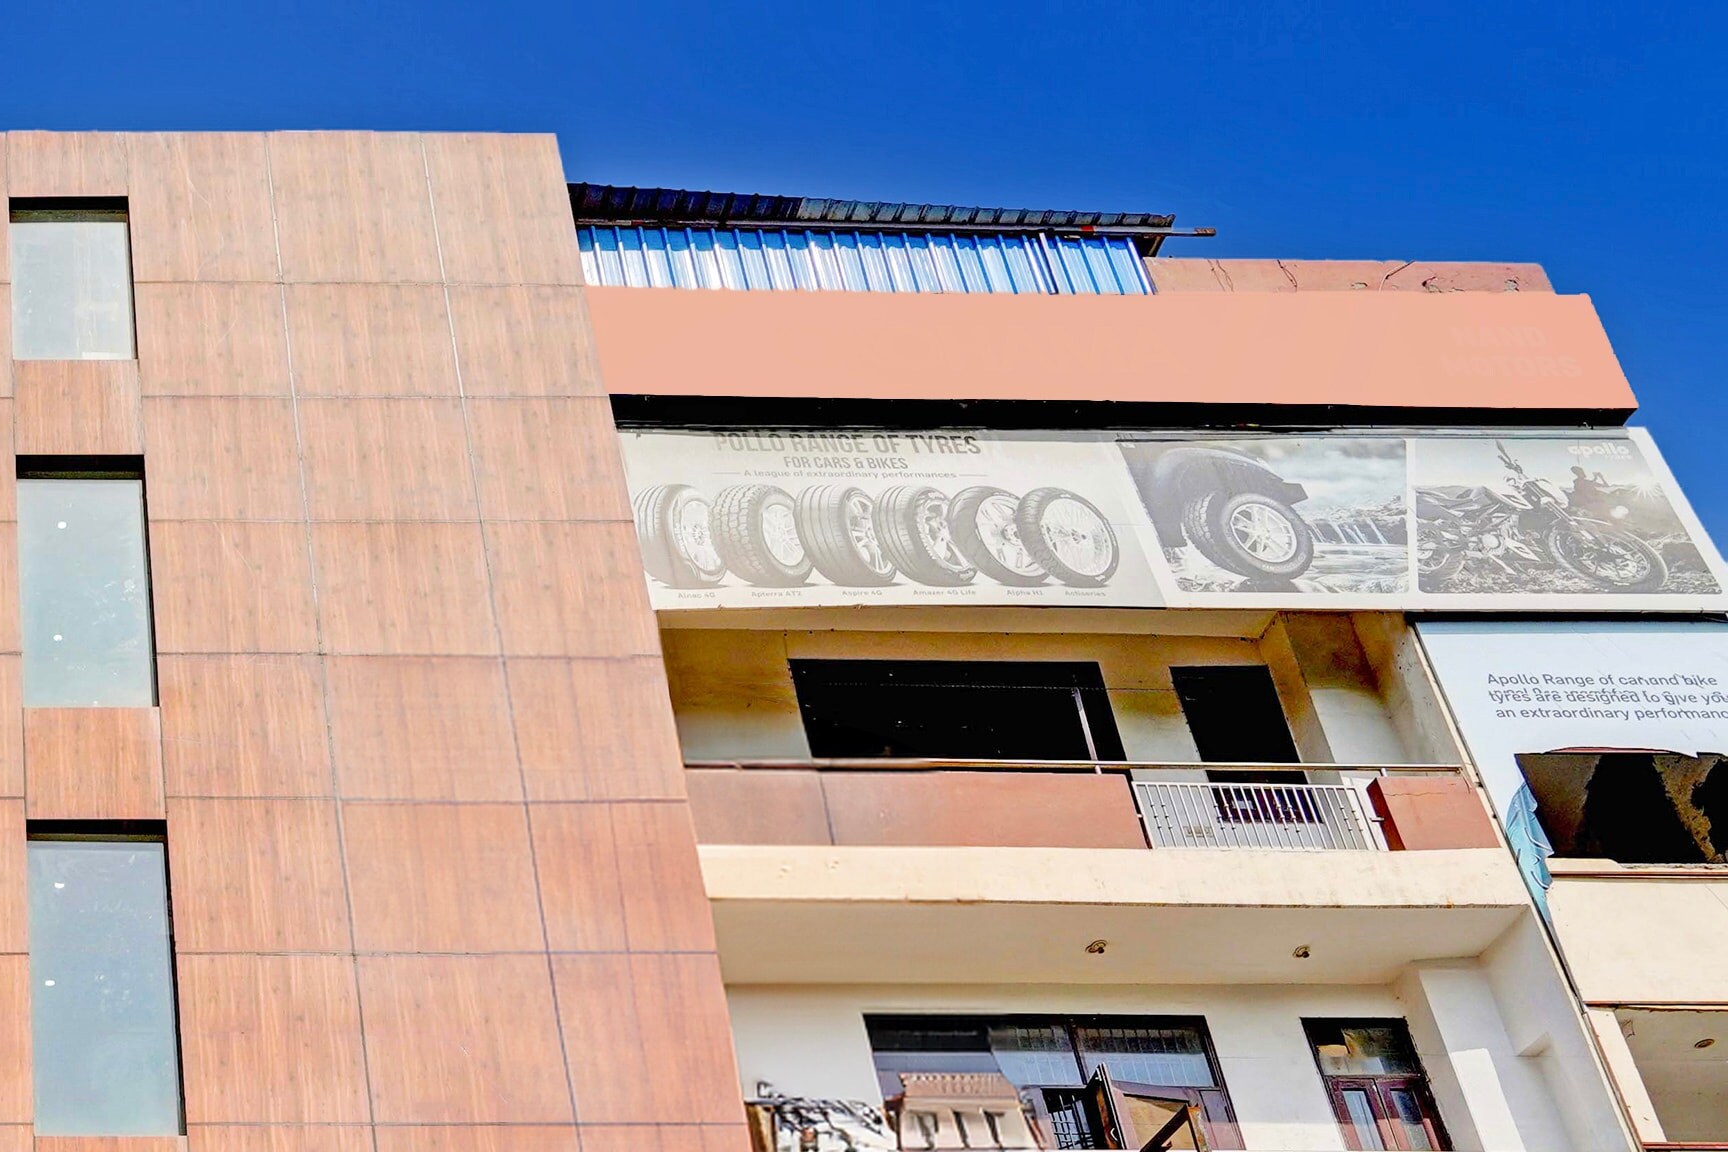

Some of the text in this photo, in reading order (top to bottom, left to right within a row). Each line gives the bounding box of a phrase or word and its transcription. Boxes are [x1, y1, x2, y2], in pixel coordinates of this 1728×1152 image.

[789, 433, 869, 452] RANGE
[872, 434, 901, 453] OF
[905, 435, 981, 454] TYRES
[784, 456, 811, 468] FOR
[813, 457, 851, 469] CARS
[866, 457, 909, 469] BIKES
[882, 471, 957, 479] performances
[1487, 673, 1540, 687] Apollo
[1542, 673, 1595, 688] Range
[1598, 674, 1615, 685] of
[1495, 708, 1517, 718] an
[1520, 706, 1629, 721] extraordinary
